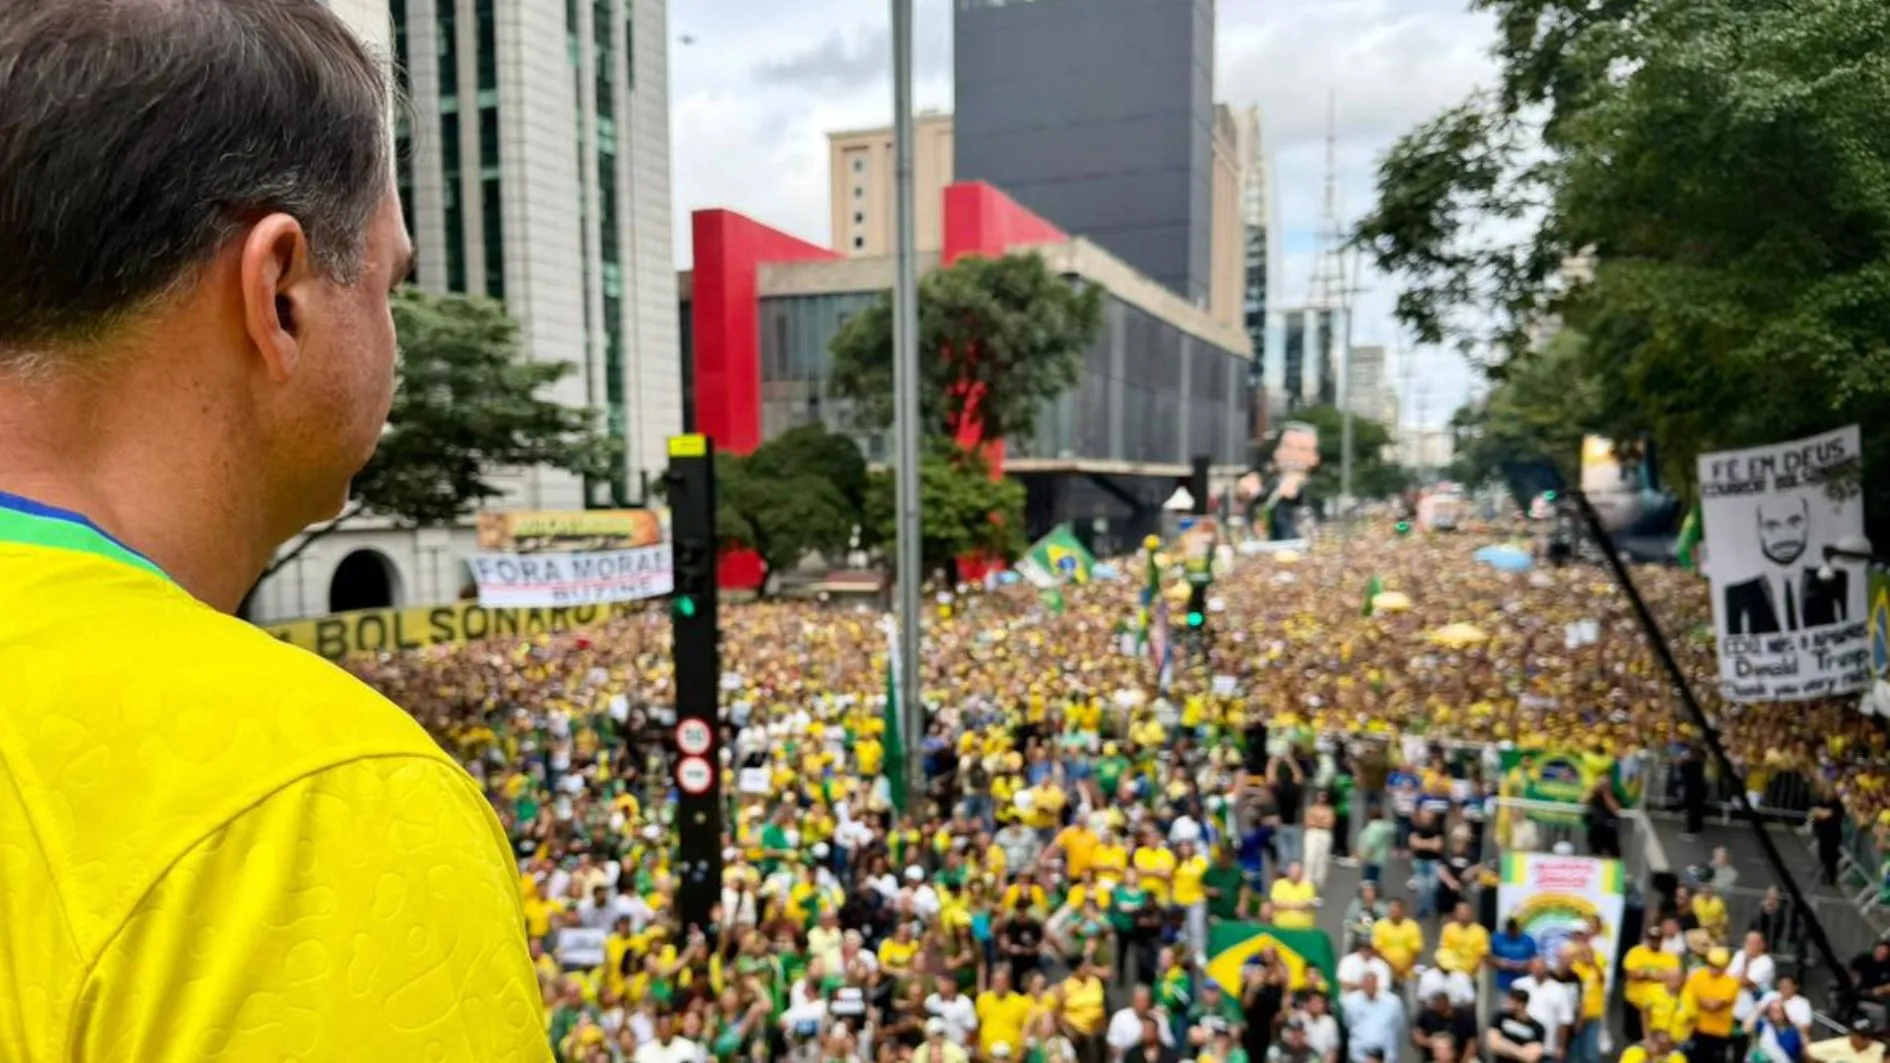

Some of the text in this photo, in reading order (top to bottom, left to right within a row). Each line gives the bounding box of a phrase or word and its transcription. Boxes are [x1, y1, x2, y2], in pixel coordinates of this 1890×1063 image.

[1784, 437, 1845, 470] DEUS
[476, 556, 564, 586] FORA
[315, 605, 597, 660] BOLSONARO
